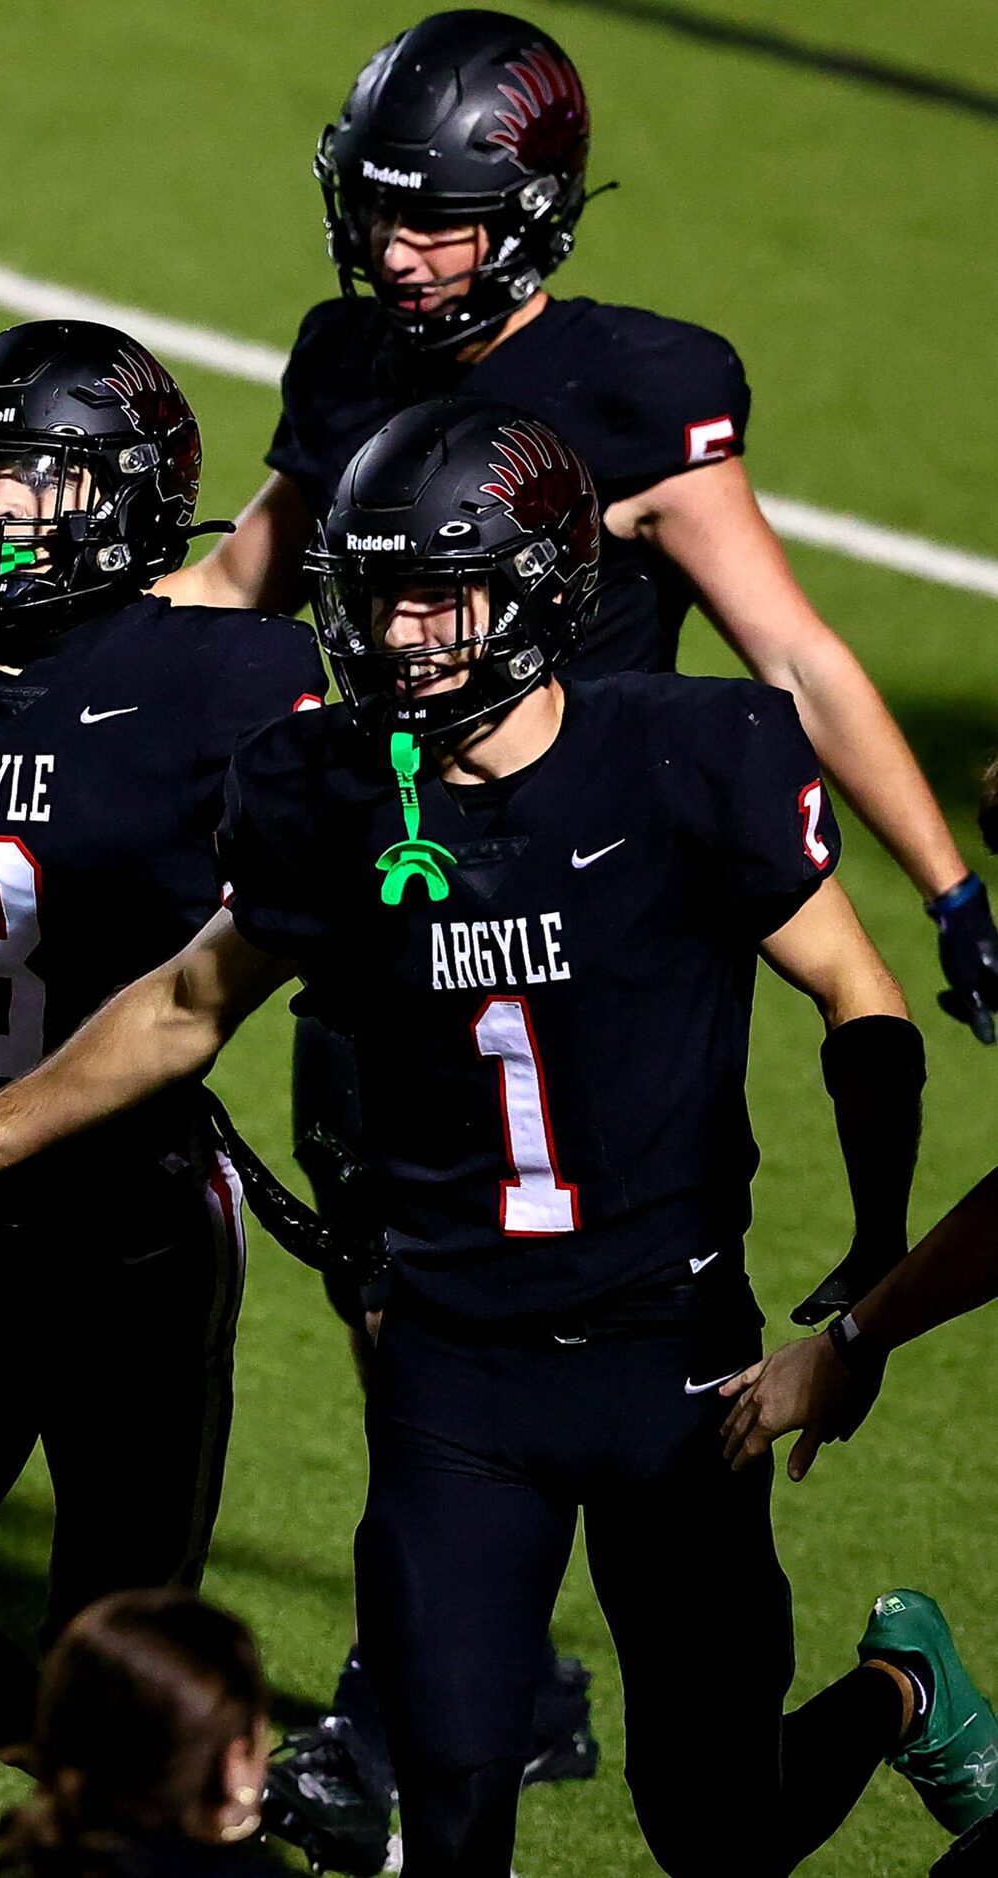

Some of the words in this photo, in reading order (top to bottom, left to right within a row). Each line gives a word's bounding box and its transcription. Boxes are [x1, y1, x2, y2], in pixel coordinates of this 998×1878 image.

[362, 160, 422, 189] Riddell
[346, 534, 406, 551] Riddell
[432, 911, 572, 992] ARGYLE
[470, 995, 581, 1238] 1
